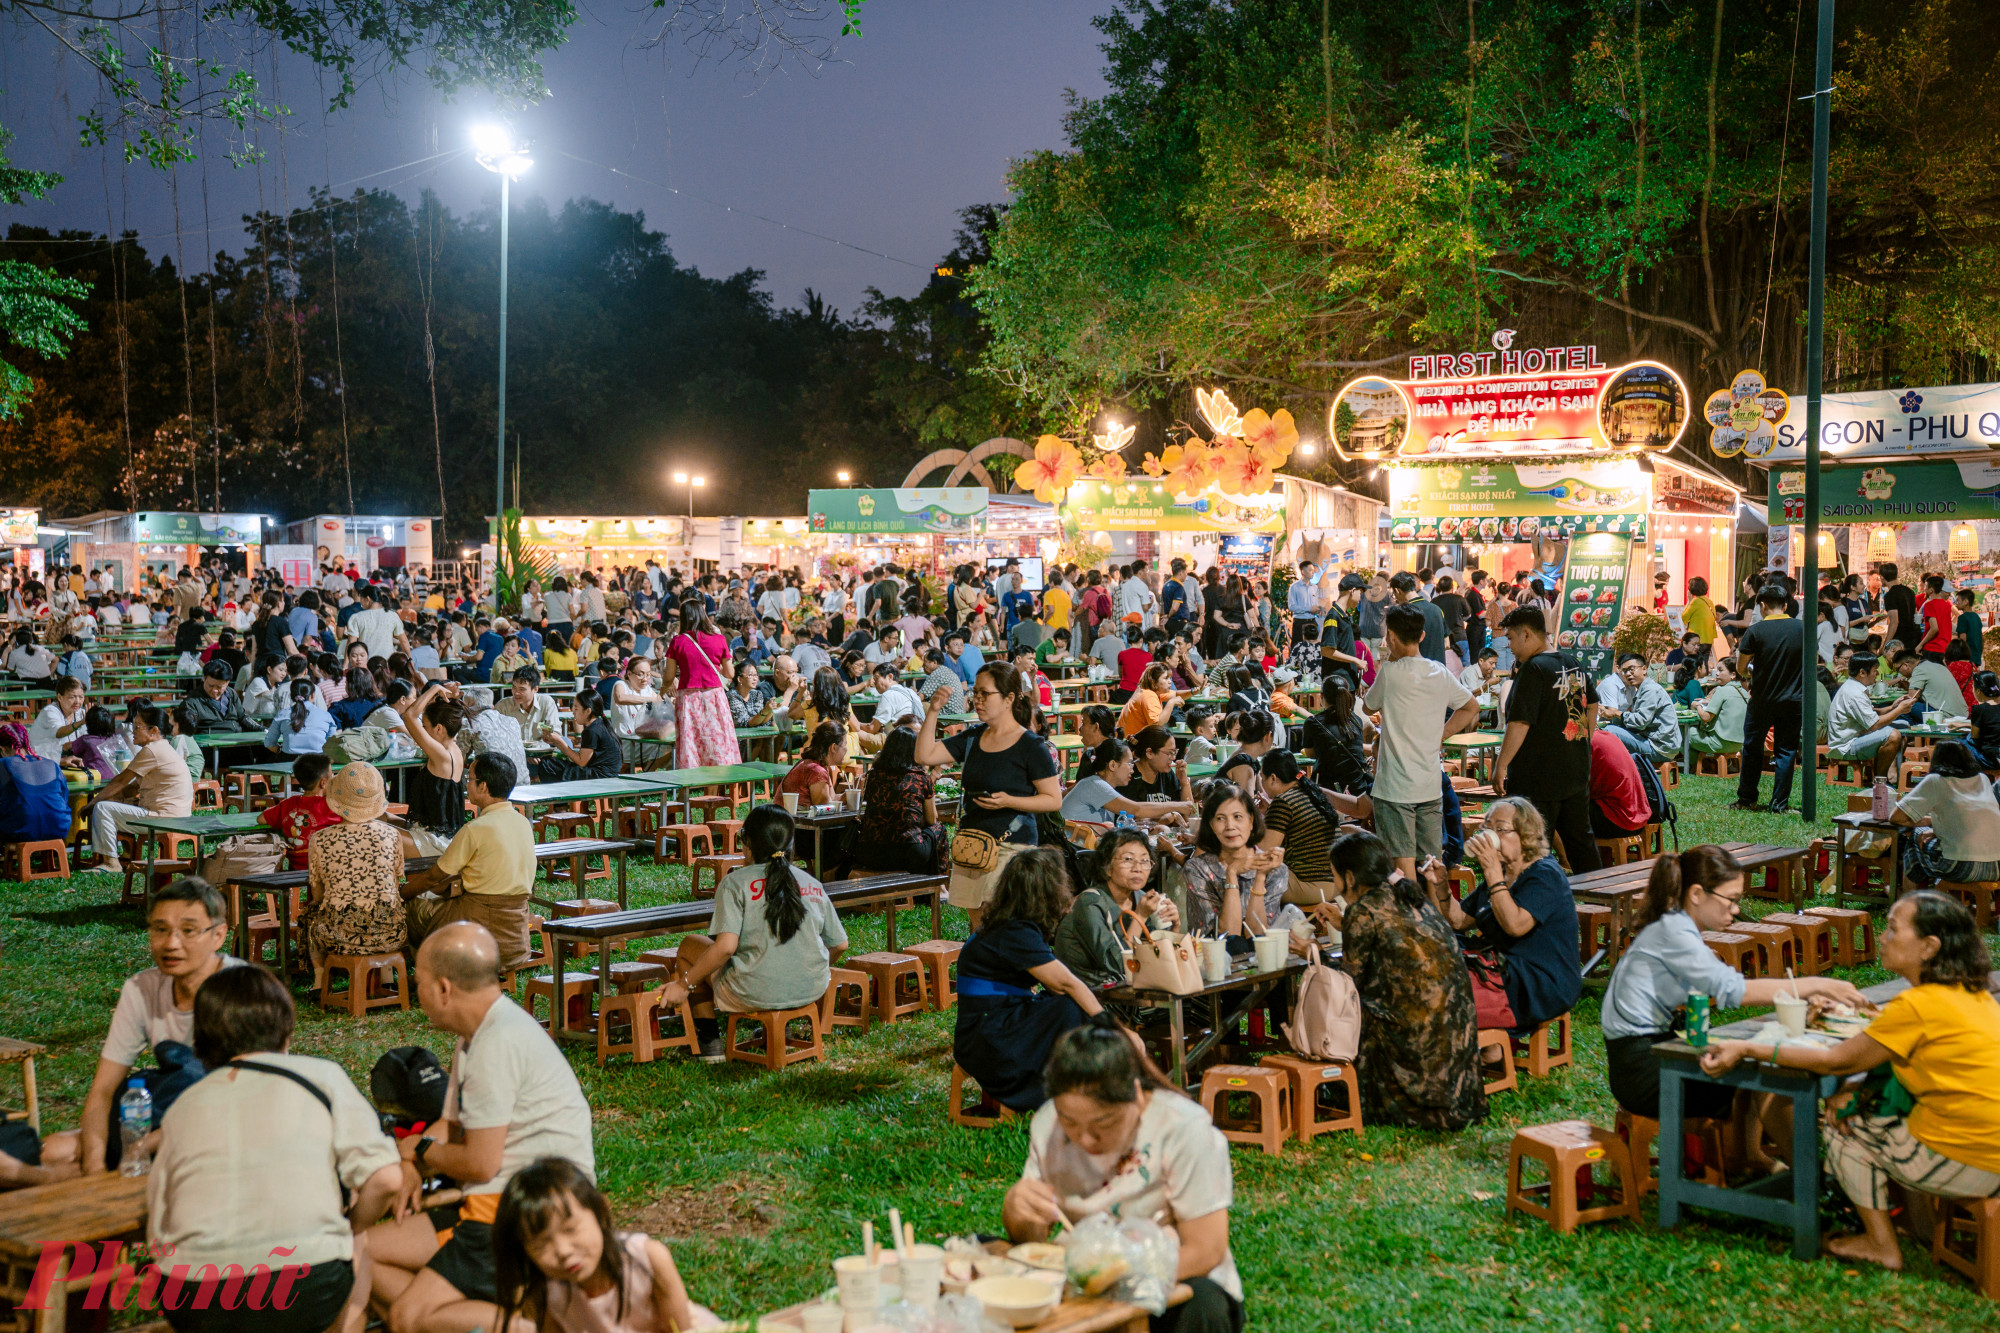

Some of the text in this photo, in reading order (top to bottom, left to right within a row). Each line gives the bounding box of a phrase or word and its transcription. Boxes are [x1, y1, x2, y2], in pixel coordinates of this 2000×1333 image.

[1409, 345, 1606, 380] FIRST HOTEL
[1413, 377, 1598, 397] WEDDING & CONVENTION CENTER
[1416, 394, 1594, 417] NHÀ HÀNG KHÁCH SẠN
[1467, 412, 1537, 435] ĐỆ NHẤT
[1778, 419, 1885, 448] SAGON
[1909, 414, 1969, 442] PHU
[1430, 490, 1459, 501] KHÁCH
[1459, 491, 1478, 502] SẠN
[1492, 487, 1517, 500] NHẤT
[1448, 502, 1496, 512] FIRST HOTEL
[1823, 503, 1874, 517] SAIGON
[1884, 501, 1913, 515] PHU
[1916, 500, 1958, 514] QUOC
[1570, 564, 1625, 583] THỰC ĐƠN
